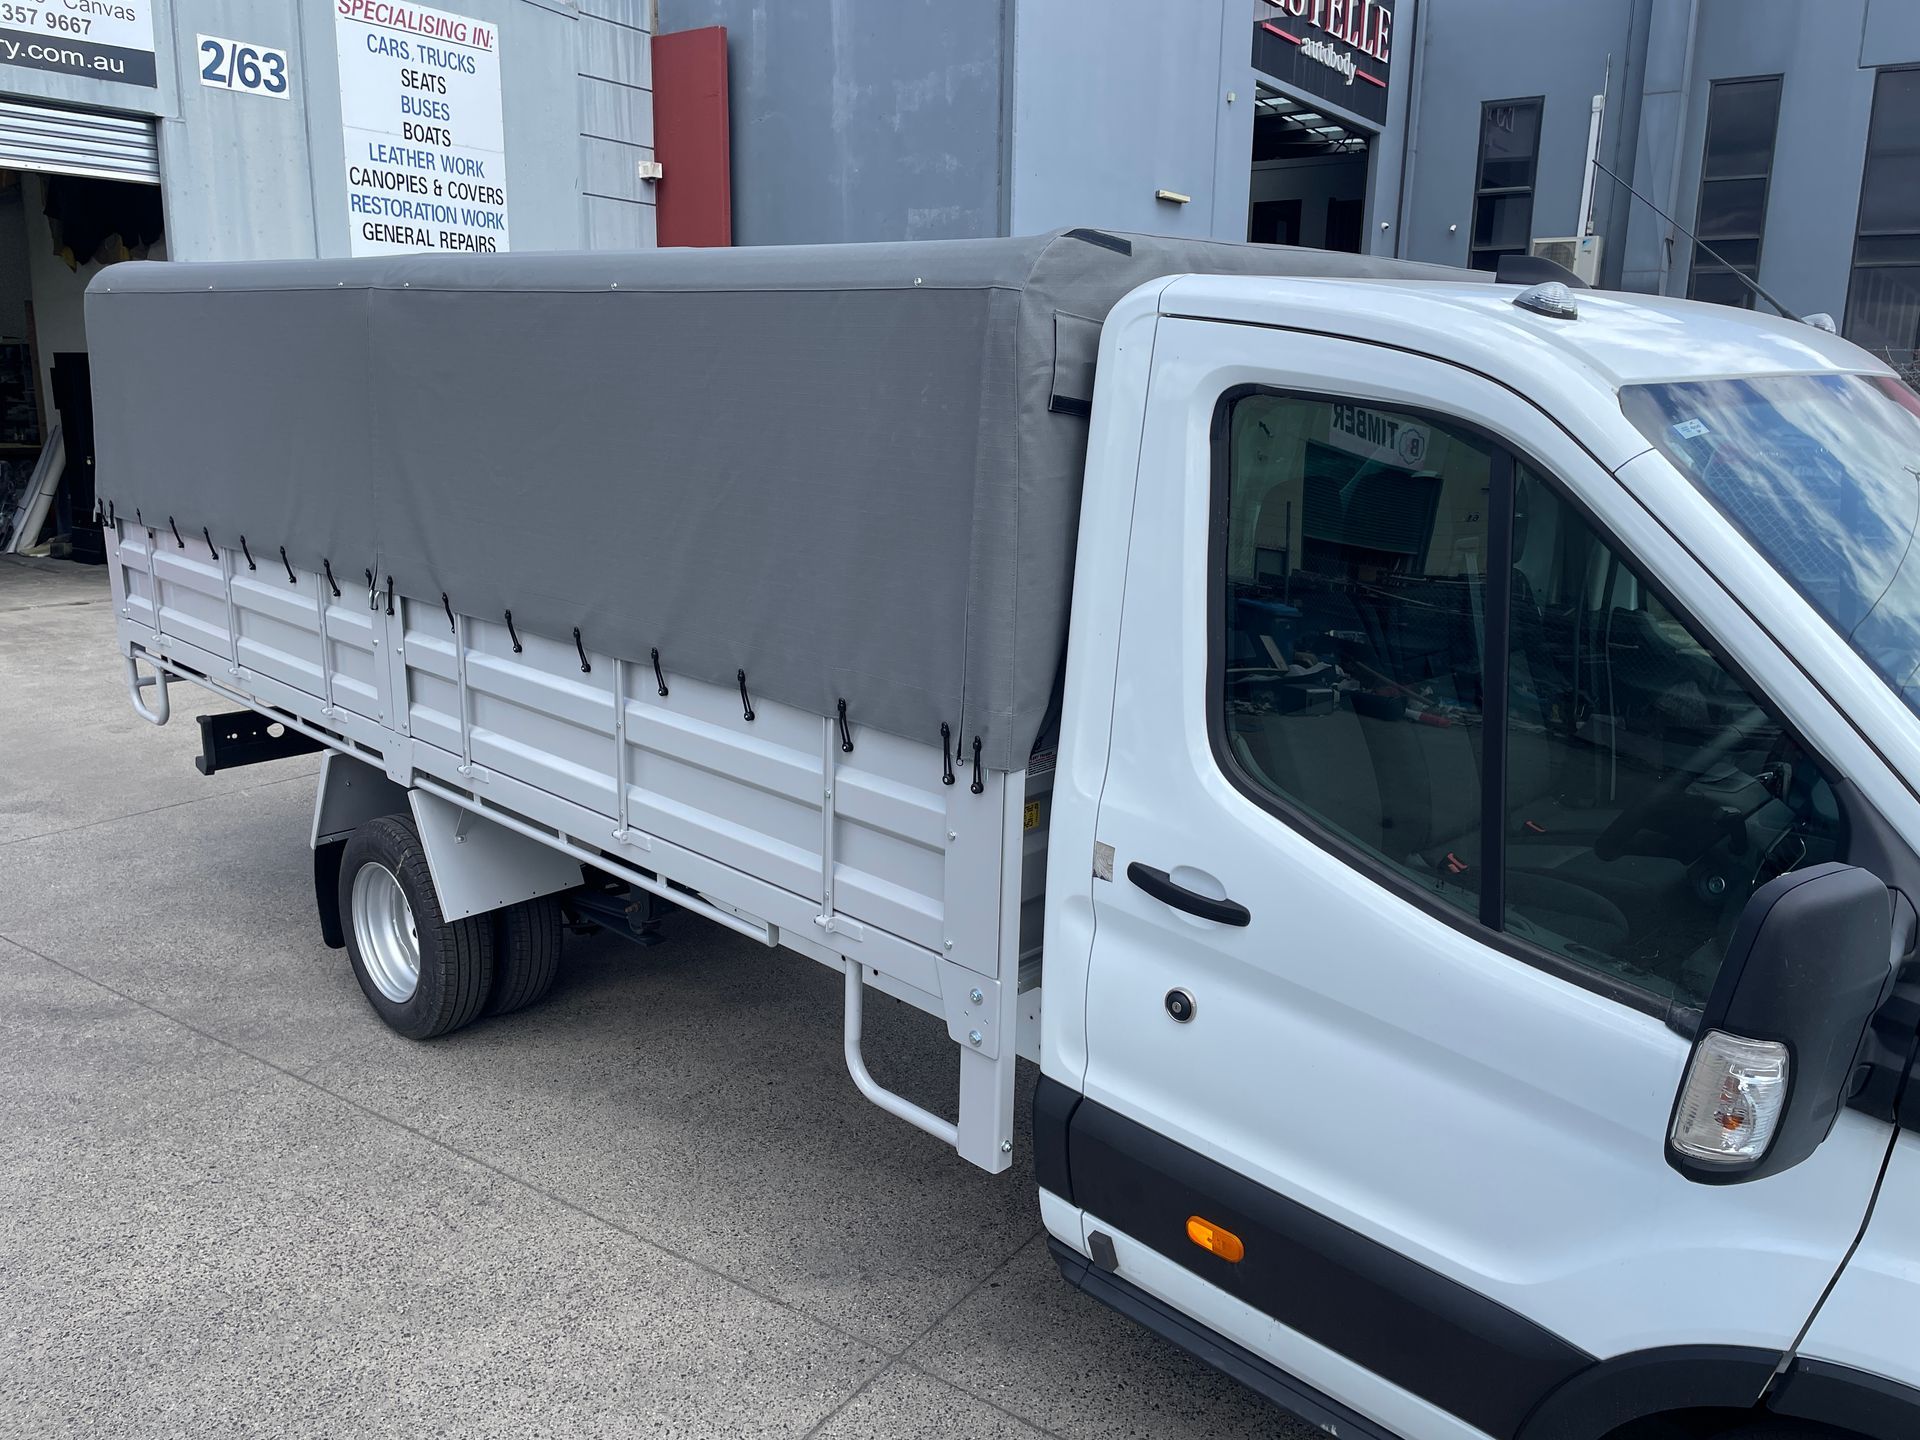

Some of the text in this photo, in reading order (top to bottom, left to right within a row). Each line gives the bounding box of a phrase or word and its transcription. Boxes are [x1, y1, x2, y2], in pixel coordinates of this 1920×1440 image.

[1, 3, 92, 35] 357 9667
[63, 0, 136, 21] Canvas
[338, 0, 494, 48] SPECIALISING IN:
[200, 40, 287, 93] 2/63
[366, 33, 476, 74] CARS, TRUCKS
[1300, 37, 1357, 86] autobody
[401, 68, 447, 94] SEATS
[401, 95, 450, 121] BUSES
[403, 122, 451, 147] BOATS
[369, 142, 485, 179] LEATHER WORK
[349, 166, 504, 206] CANOPIES & COVERS
[351, 193, 505, 230] RESTORATION WORK
[362, 222, 496, 253] GENERAL REPAIRS
